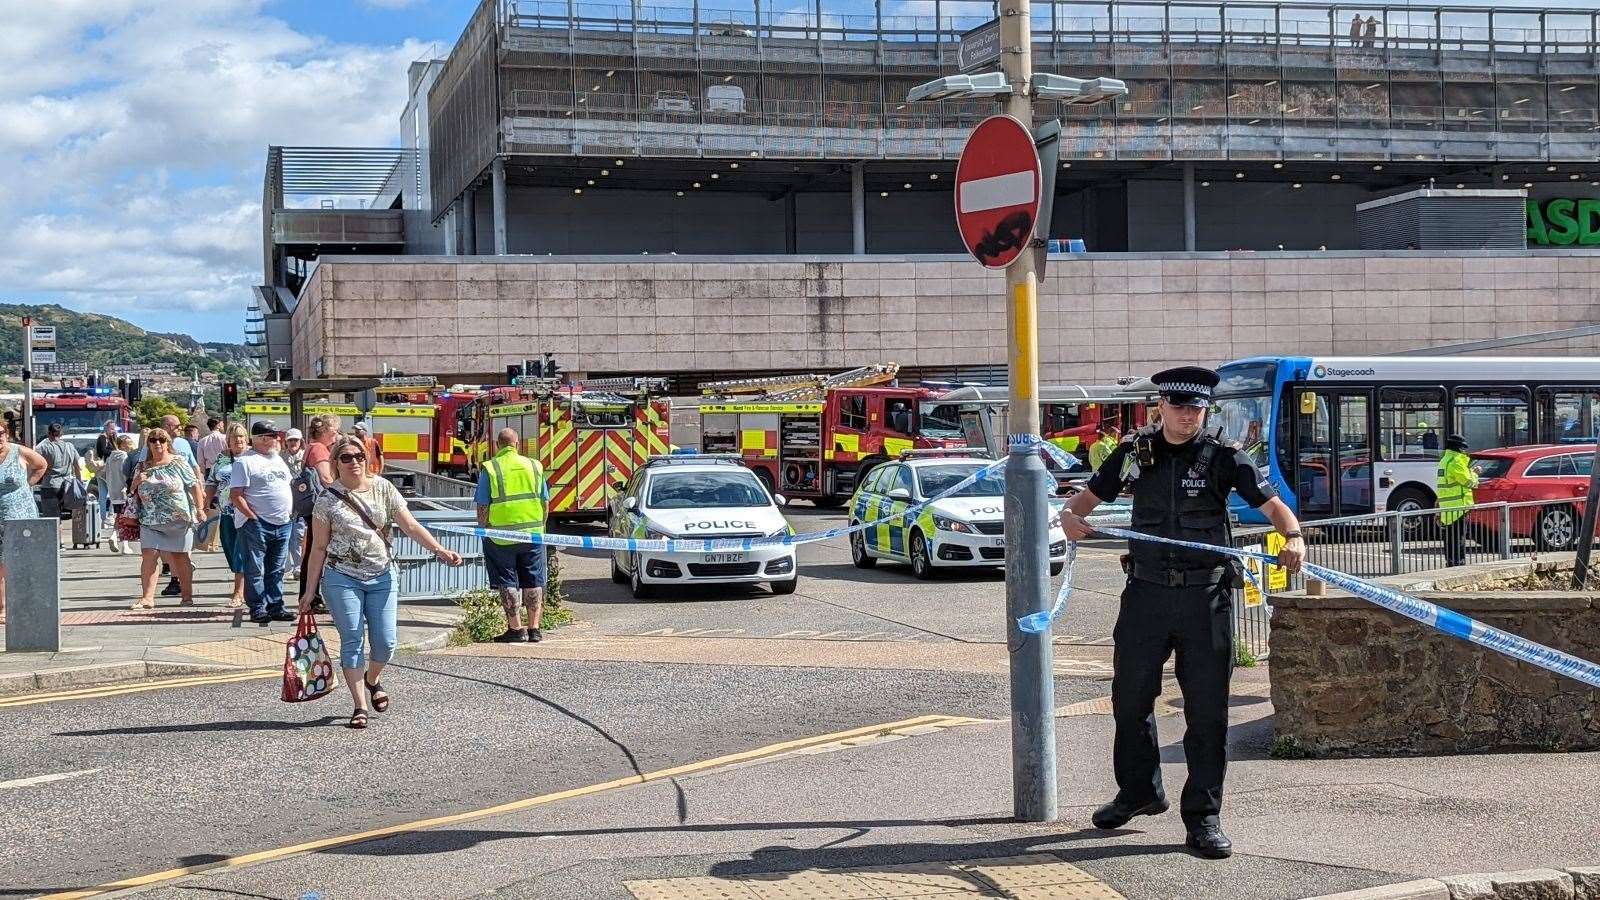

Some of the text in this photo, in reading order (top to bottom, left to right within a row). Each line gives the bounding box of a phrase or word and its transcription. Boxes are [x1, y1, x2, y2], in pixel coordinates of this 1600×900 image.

[1327, 367, 1375, 377] Stagecoach
[1182, 479, 1205, 488] POLICE
[684, 520, 757, 531] POLICE
[704, 553, 743, 563] GN71 BZF
